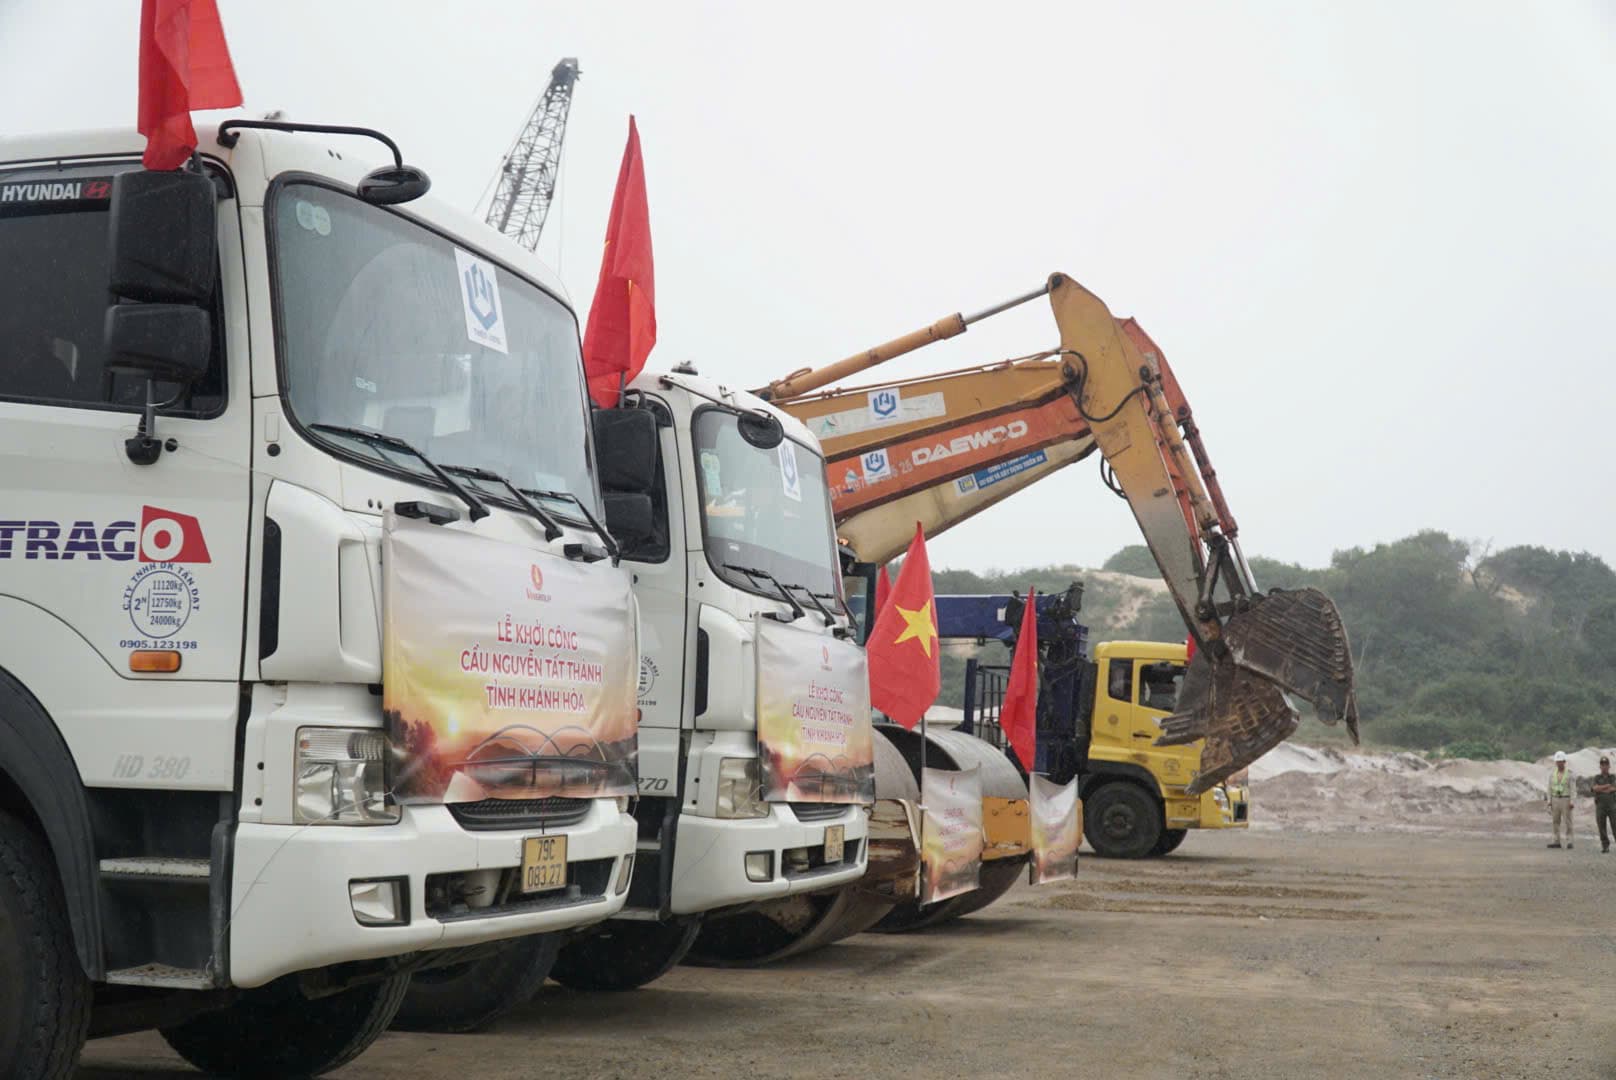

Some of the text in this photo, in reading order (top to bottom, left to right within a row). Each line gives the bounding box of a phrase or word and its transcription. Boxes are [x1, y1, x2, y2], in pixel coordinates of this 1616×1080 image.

[2, 183, 82, 201] HYUNDAI
[911, 420, 1028, 466] DAEWOO
[152, 580, 183, 592] 11120kg
[151, 597, 182, 609] 12750kg
[497, 613, 578, 651] LỄ KHỞI CÔNG
[119, 639, 198, 649] 0905.123198
[460, 643, 602, 683] CẦU NGUYỄN TẤT THÀNH
[519, 685, 560, 710] KHÁNH
[562, 688, 586, 711] HÒA
